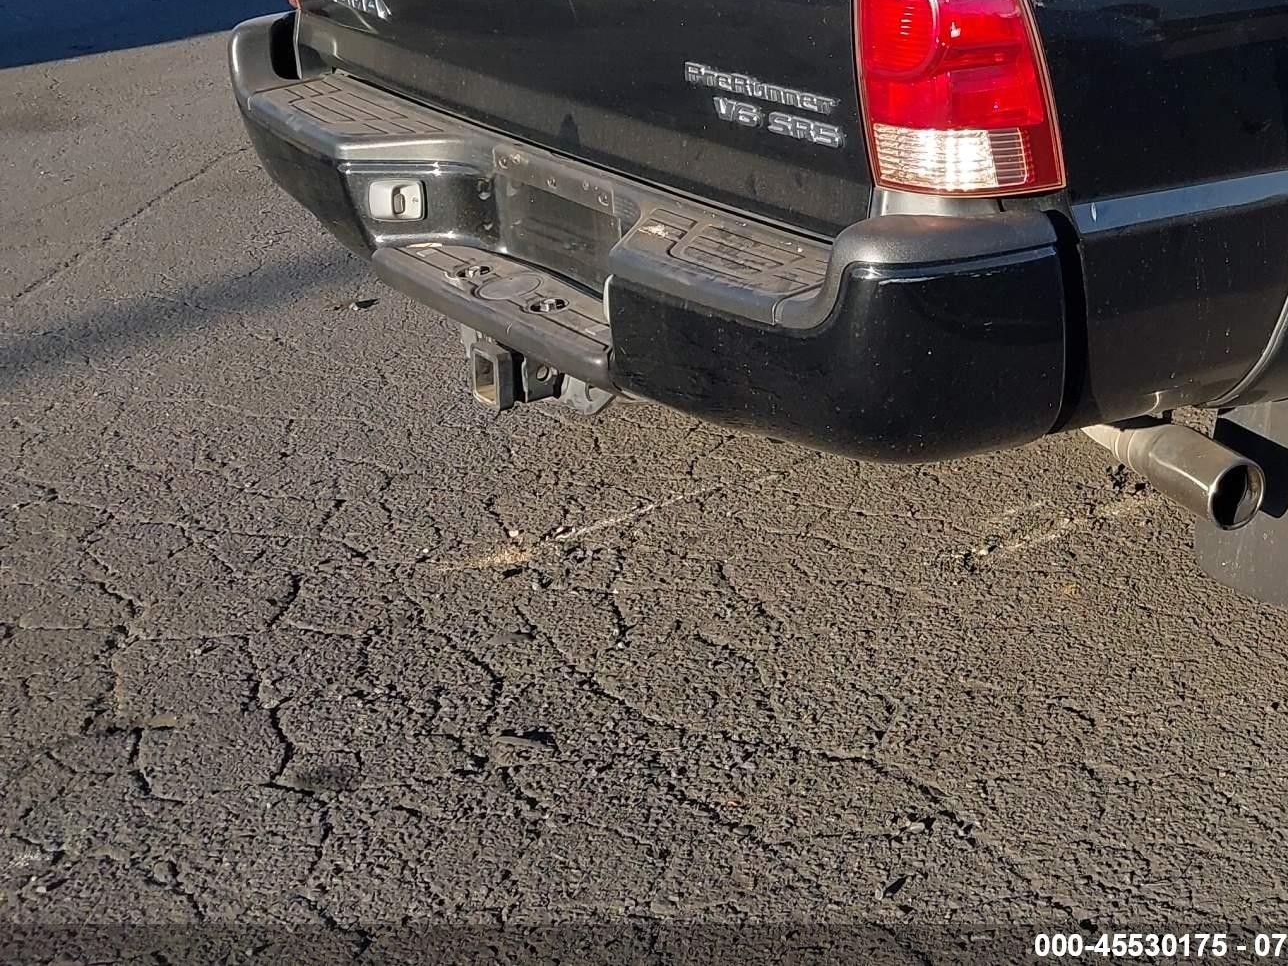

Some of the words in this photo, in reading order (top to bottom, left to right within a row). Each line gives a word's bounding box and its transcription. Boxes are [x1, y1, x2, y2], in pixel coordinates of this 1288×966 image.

[685, 61, 840, 115] PreRunner
[713, 97, 764, 128] V6
[767, 111, 846, 149] SR5
